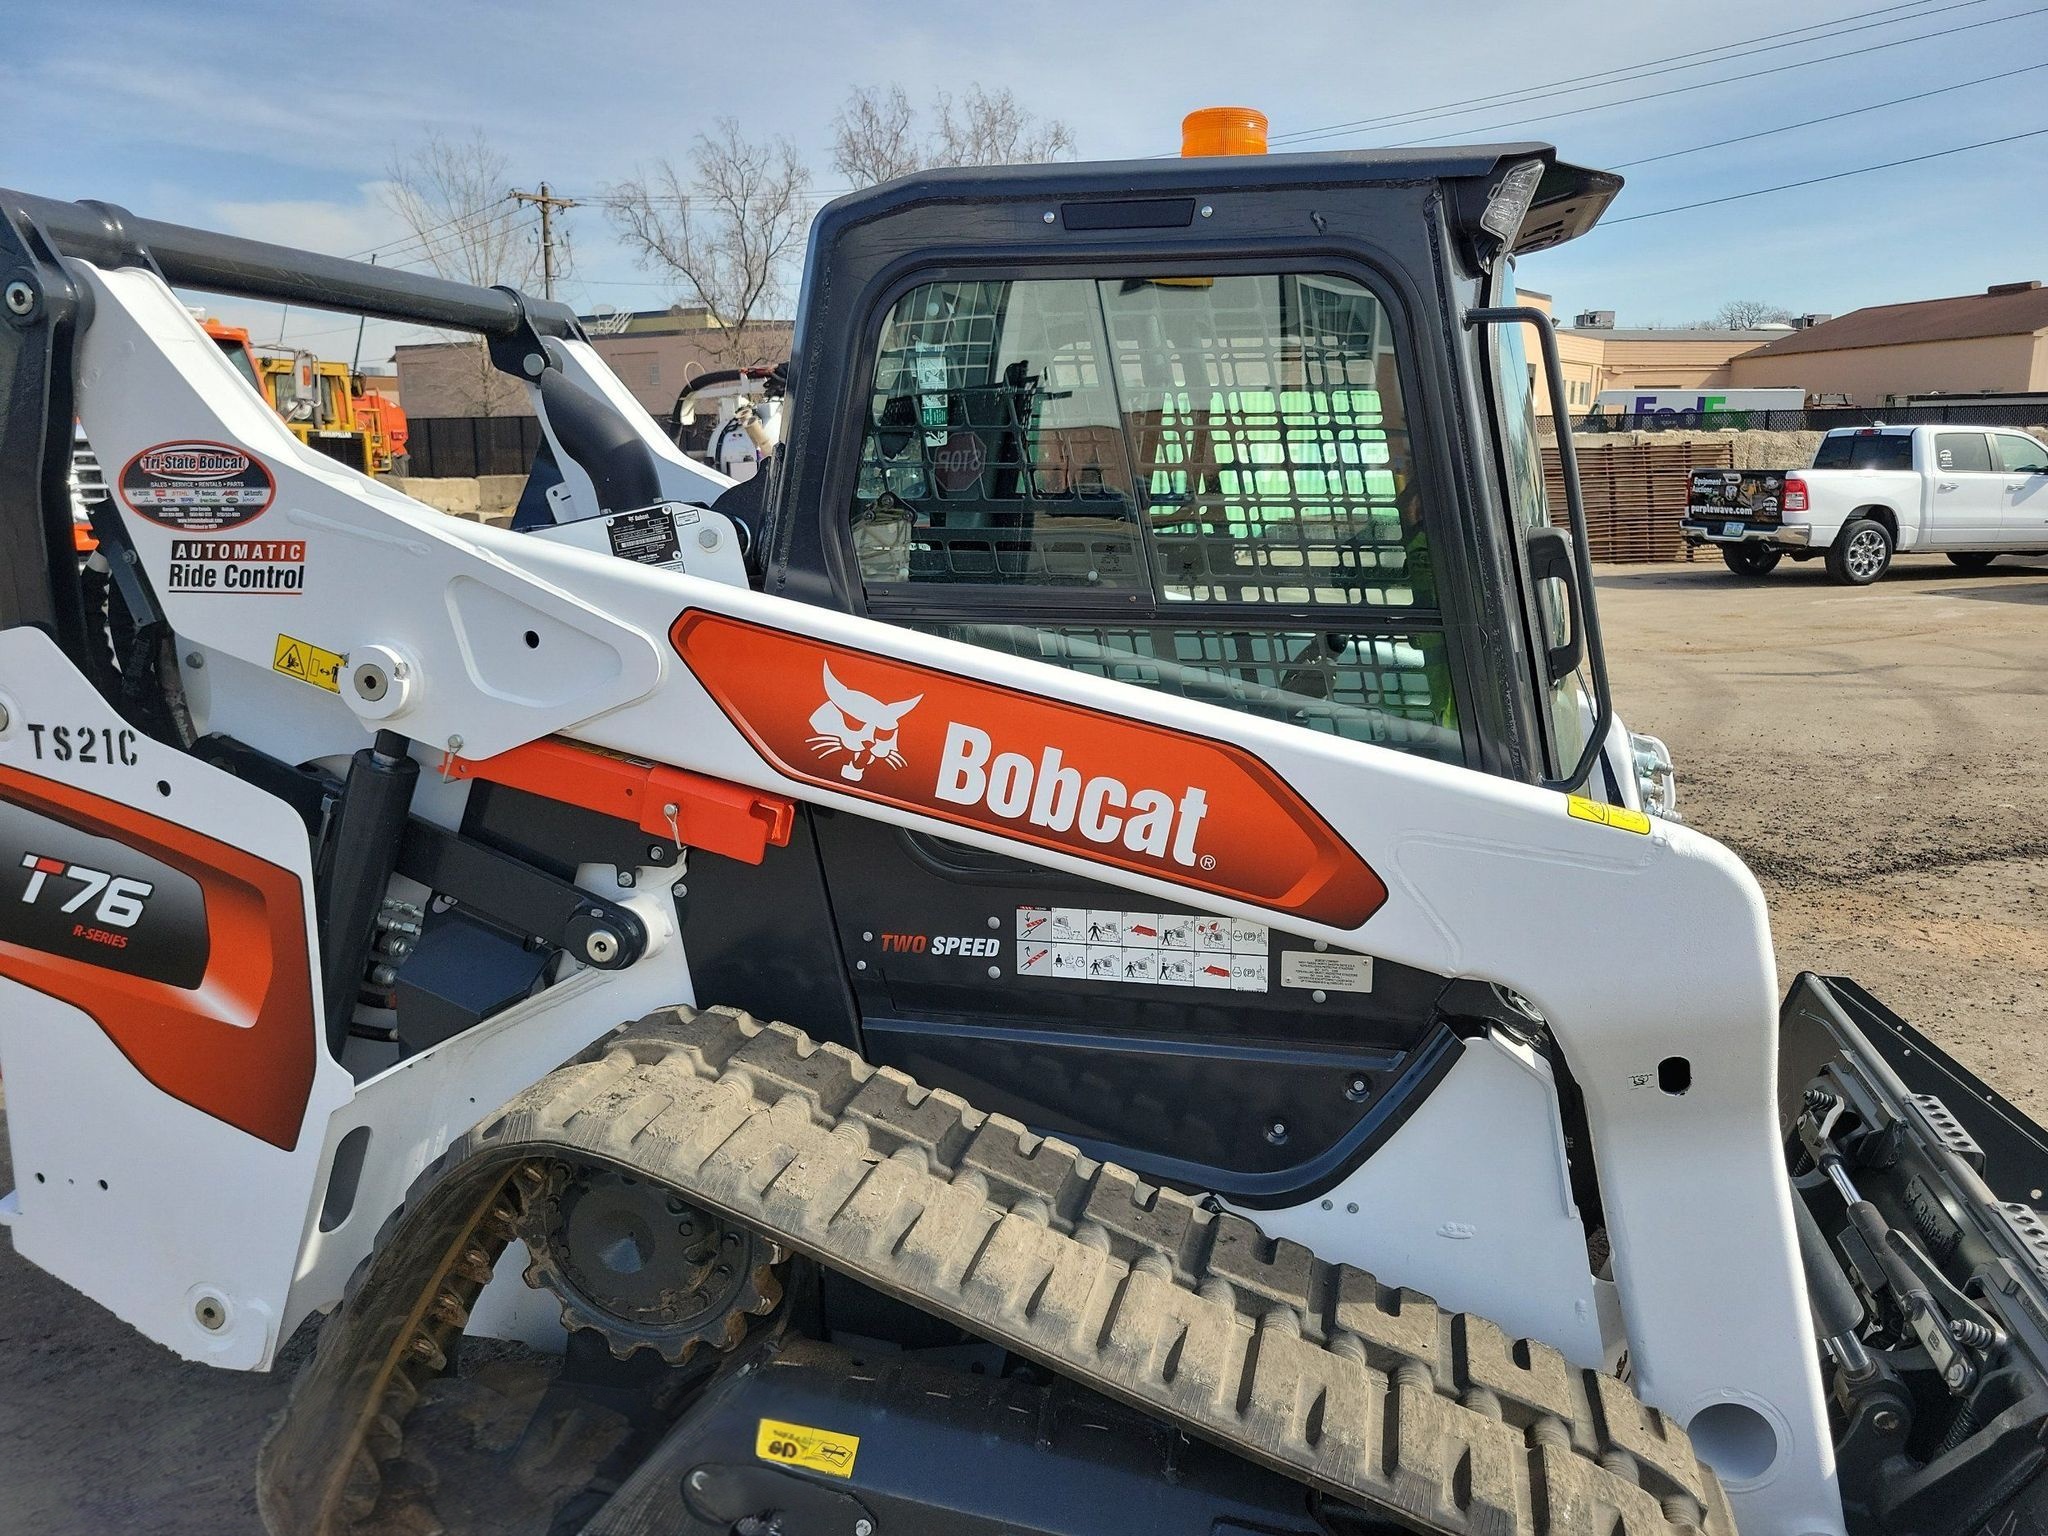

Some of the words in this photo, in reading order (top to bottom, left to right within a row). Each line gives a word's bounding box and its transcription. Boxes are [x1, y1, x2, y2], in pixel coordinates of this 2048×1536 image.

[143, 455, 197, 470] Tri-State
[199, 455, 245, 470] Bobcat
[1691, 503, 1753, 516] purplewave.com
[175, 543, 302, 560] AUTOMATIC
[169, 563, 218, 588] Ride
[224, 563, 305, 589] Control
[27, 724, 138, 766] TS21C
[934, 720, 1209, 868] Bobcat
[21, 853, 154, 929] T76
[72, 924, 129, 949] R-SERIES
[880, 933, 928, 954] TWO
[930, 936, 1001, 957] SPEED
